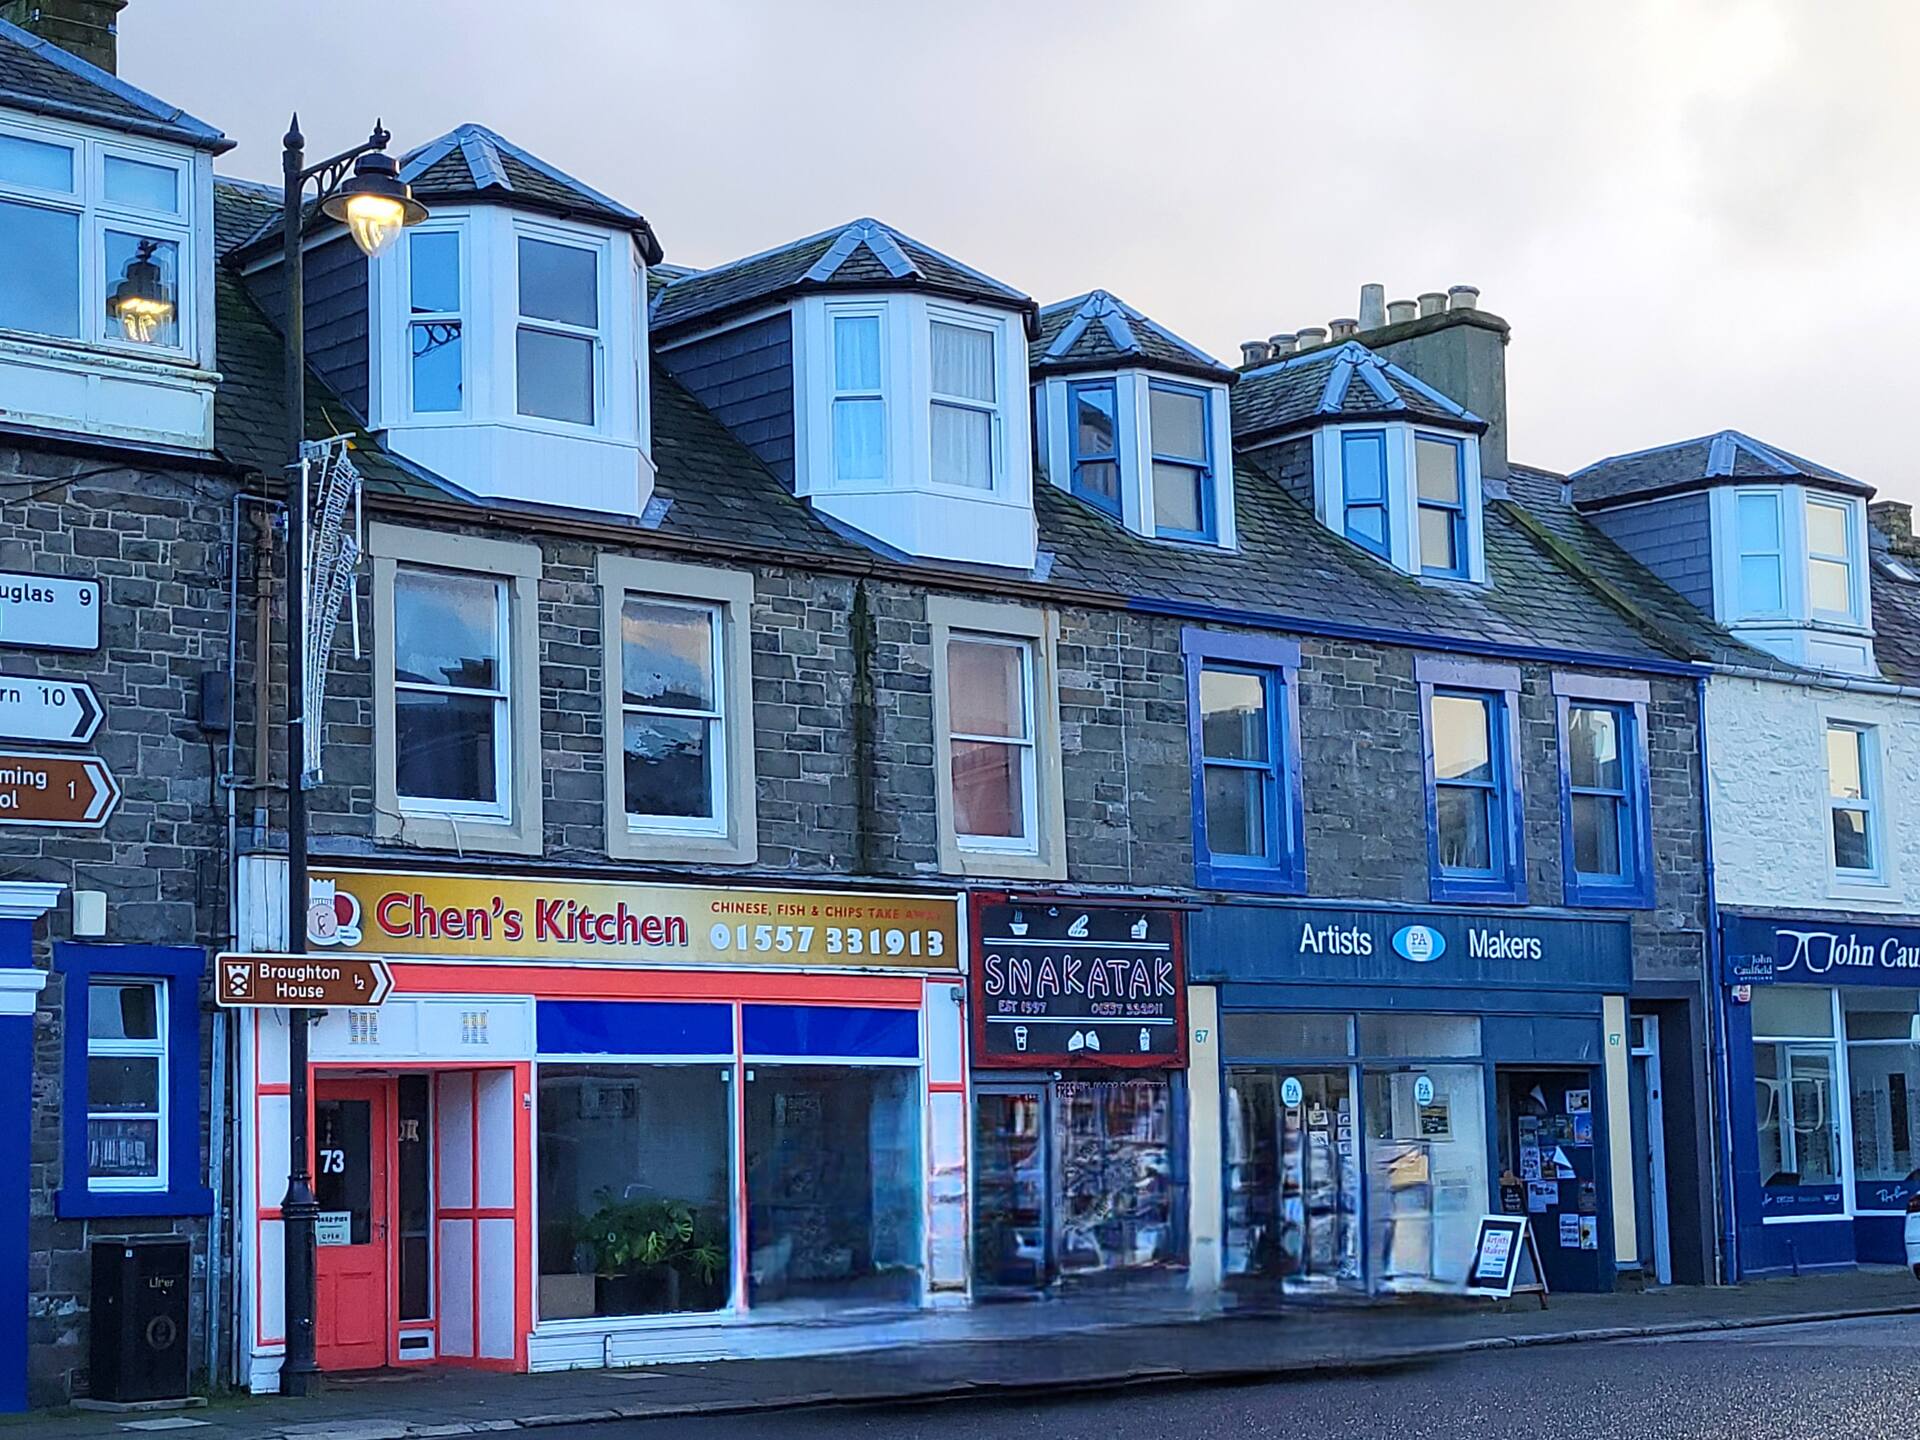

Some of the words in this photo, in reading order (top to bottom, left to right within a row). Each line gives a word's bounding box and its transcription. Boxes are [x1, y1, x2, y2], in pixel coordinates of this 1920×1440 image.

[79, 588, 92, 605] 9
[42, 687, 65, 705] 10
[67, 781, 75, 799] 1
[375, 891, 522, 941] Chen's
[535, 898, 688, 947] Kitchen
[711, 901, 772, 916] CHINESE,
[777, 904, 805, 917] FISH
[811, 905, 819, 916] &
[825, 906, 862, 919] CHIPS
[868, 907, 899, 919] TAKE
[709, 922, 815, 952] 01557
[826, 927, 944, 957] 331913
[1299, 922, 1373, 956] Artists
[1411, 932, 1428, 945] PA
[1469, 928, 1542, 961] Makers
[1751, 954, 1772, 965] John
[1825, 934, 1874, 972] John
[1880, 937, 1920, 968] Cau
[259, 963, 340, 982] Broughton
[985, 954, 1175, 999] SNAKATAK
[276, 982, 324, 998] House
[998, 1000, 1017, 1013] EST
[1286, 1084, 1298, 1097] PA
[1418, 1083, 1430, 1096] PA
[320, 1150, 345, 1173] 73
